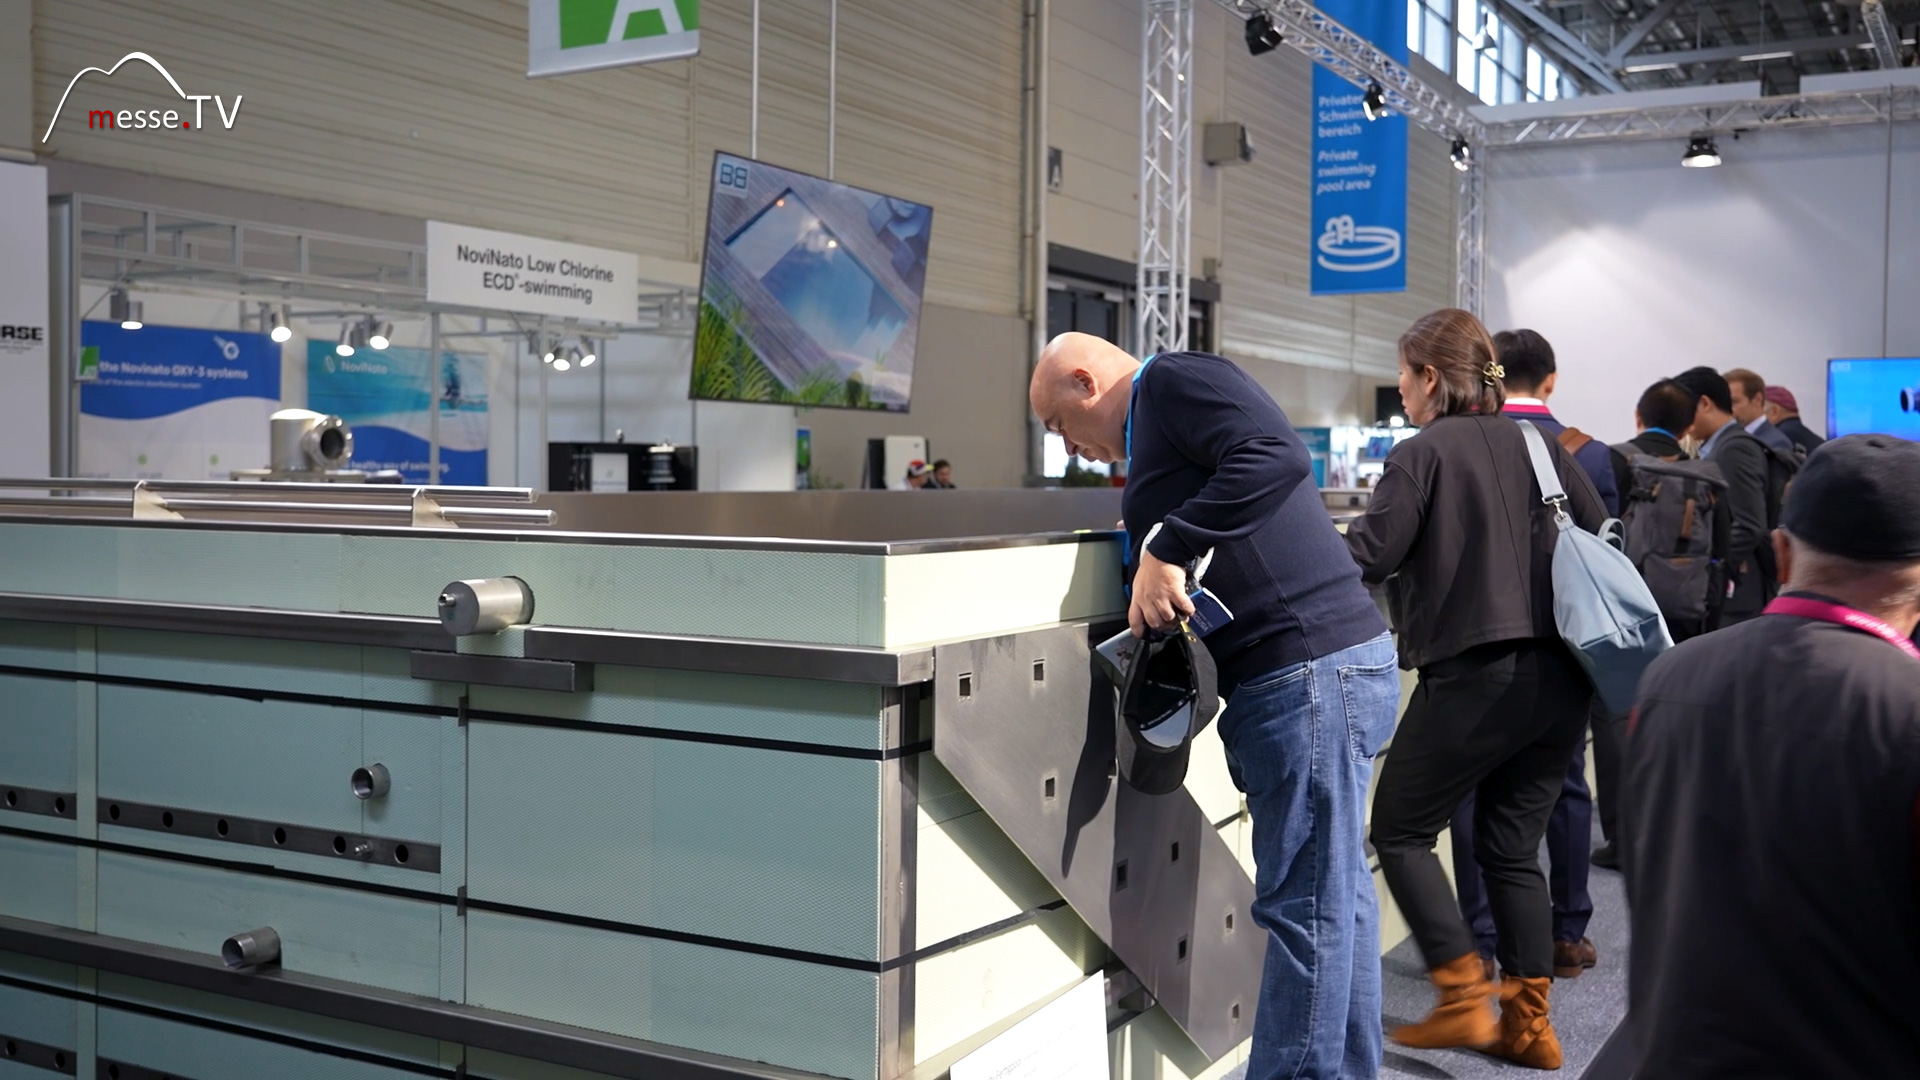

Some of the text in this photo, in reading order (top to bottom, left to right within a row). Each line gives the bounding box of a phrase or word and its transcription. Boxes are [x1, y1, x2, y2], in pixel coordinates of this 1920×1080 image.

[1319, 123, 1362, 138] bereich
[1318, 150, 1359, 162] Private
[1318, 163, 1376, 177] swimming
[1317, 180, 1371, 196] pool area
[457, 245, 614, 282] NoviNato Low Chlorine
[100, 361, 119, 373] the
[207, 367, 248, 381] systems
